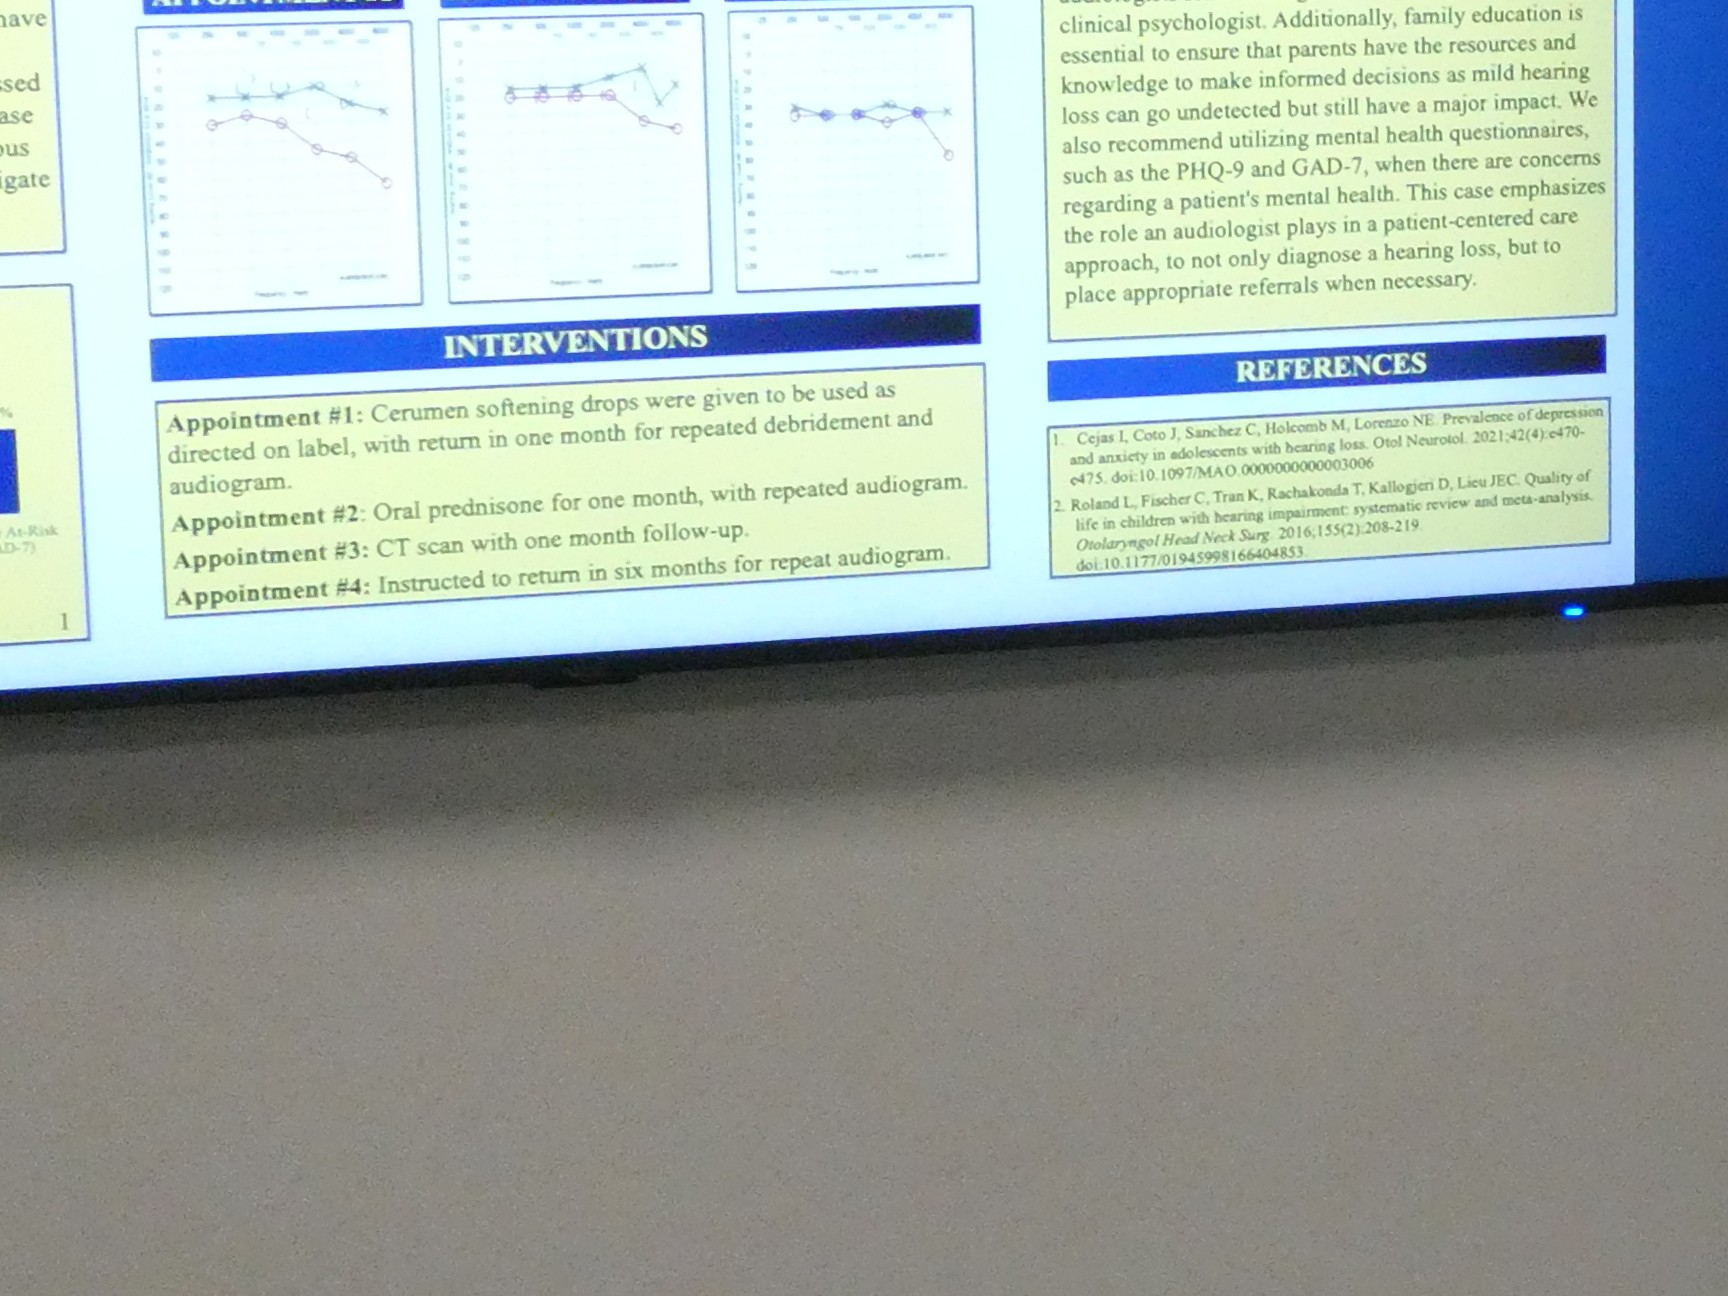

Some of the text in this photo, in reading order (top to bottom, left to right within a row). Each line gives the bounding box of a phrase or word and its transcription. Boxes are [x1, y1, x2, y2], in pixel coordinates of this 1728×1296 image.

[1065, 273, 1477, 309] place appropriate referrals when necessary.
[443, 323, 708, 359] INTERVENTIONS
[1236, 351, 1428, 383] REFERENCES
[171, 507, 326, 537] Appointment
[373, 500, 421, 522] Oral
[428, 497, 544, 524] prednisone
[551, 492, 582, 512] for
[588, 494, 625, 510] one
[632, 485, 704, 508] month,
[710, 482, 757, 502] with
[763, 477, 849, 505] repeated
[855, 474, 968, 497] audiogram.
